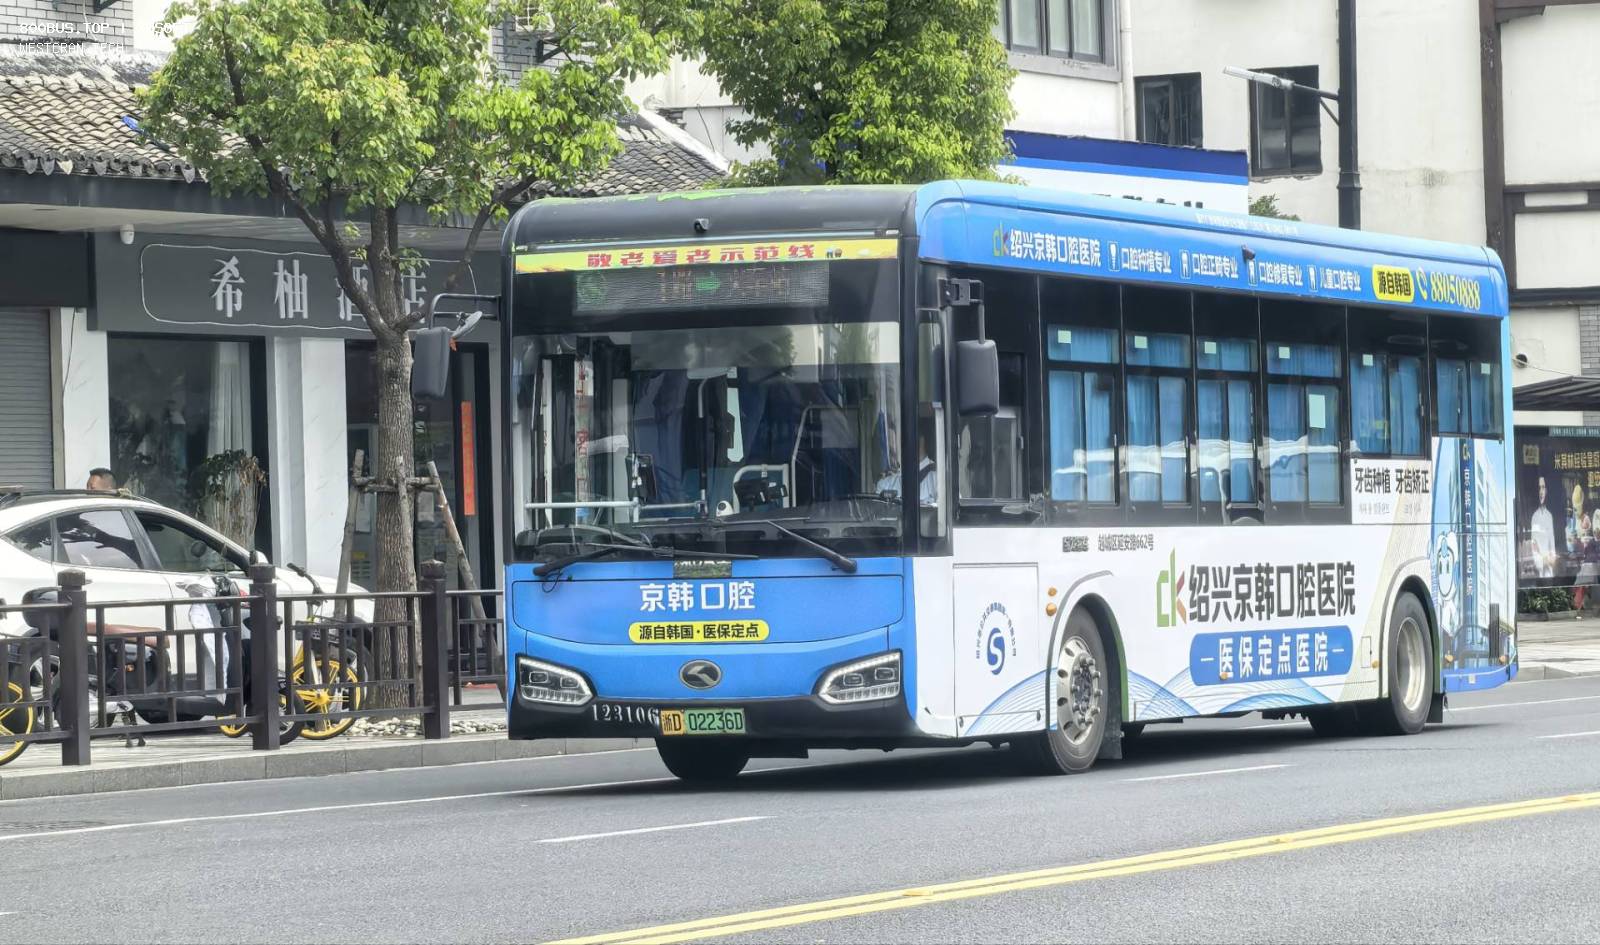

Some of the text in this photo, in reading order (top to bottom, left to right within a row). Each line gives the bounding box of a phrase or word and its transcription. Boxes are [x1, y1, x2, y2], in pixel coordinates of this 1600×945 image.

[587, 244, 815, 268] 敬老爱老示范线
[1010, 229, 1101, 267] 绍兴京韩口腔医院
[1377, 270, 1412, 297] 源自韩国
[1429, 271, 1481, 311] 88050888
[1354, 467, 1430, 494] 牙齿种植 牙齿矫正
[639, 581, 756, 612] 京韩口腔
[1188, 561, 1356, 623] 绍兴京韩口腔医院
[1219, 630, 1330, 679] 医保定点医院
